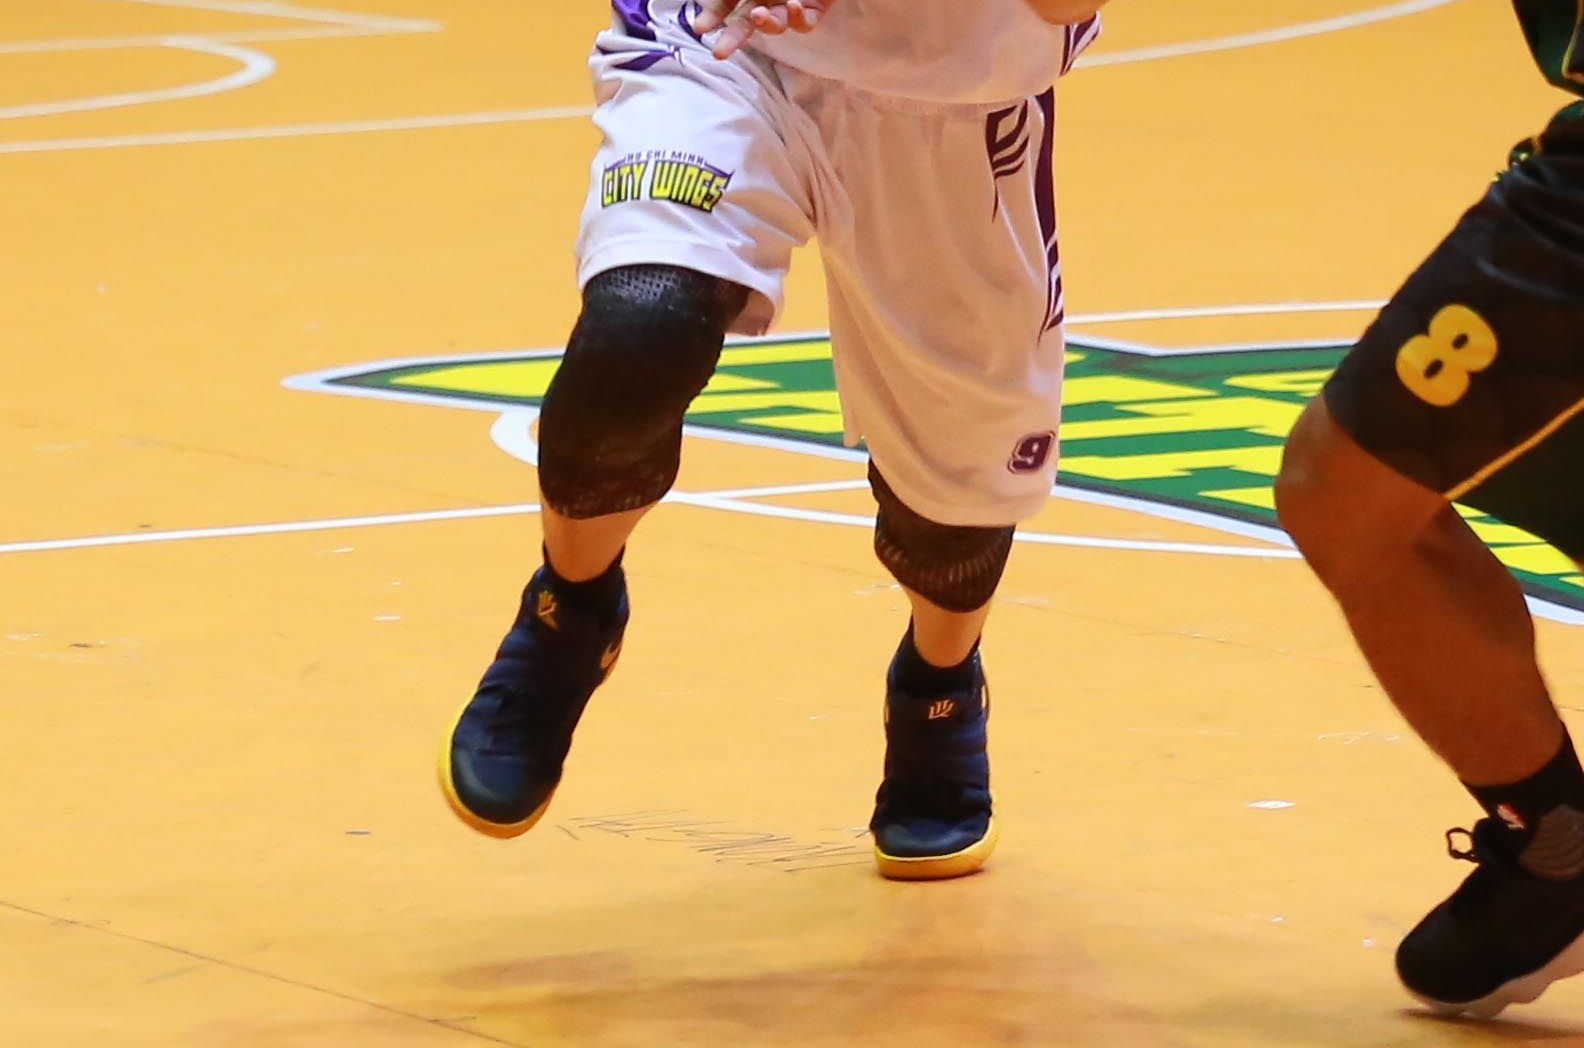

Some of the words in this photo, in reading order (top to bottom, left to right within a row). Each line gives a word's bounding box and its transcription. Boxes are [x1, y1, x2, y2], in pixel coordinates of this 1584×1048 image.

[671, 152, 705, 166] MINH
[602, 159, 649, 209] CITY
[649, 158, 729, 214] WINGS
[1395, 303, 1498, 407] 8
[1007, 430, 1056, 474] 9
